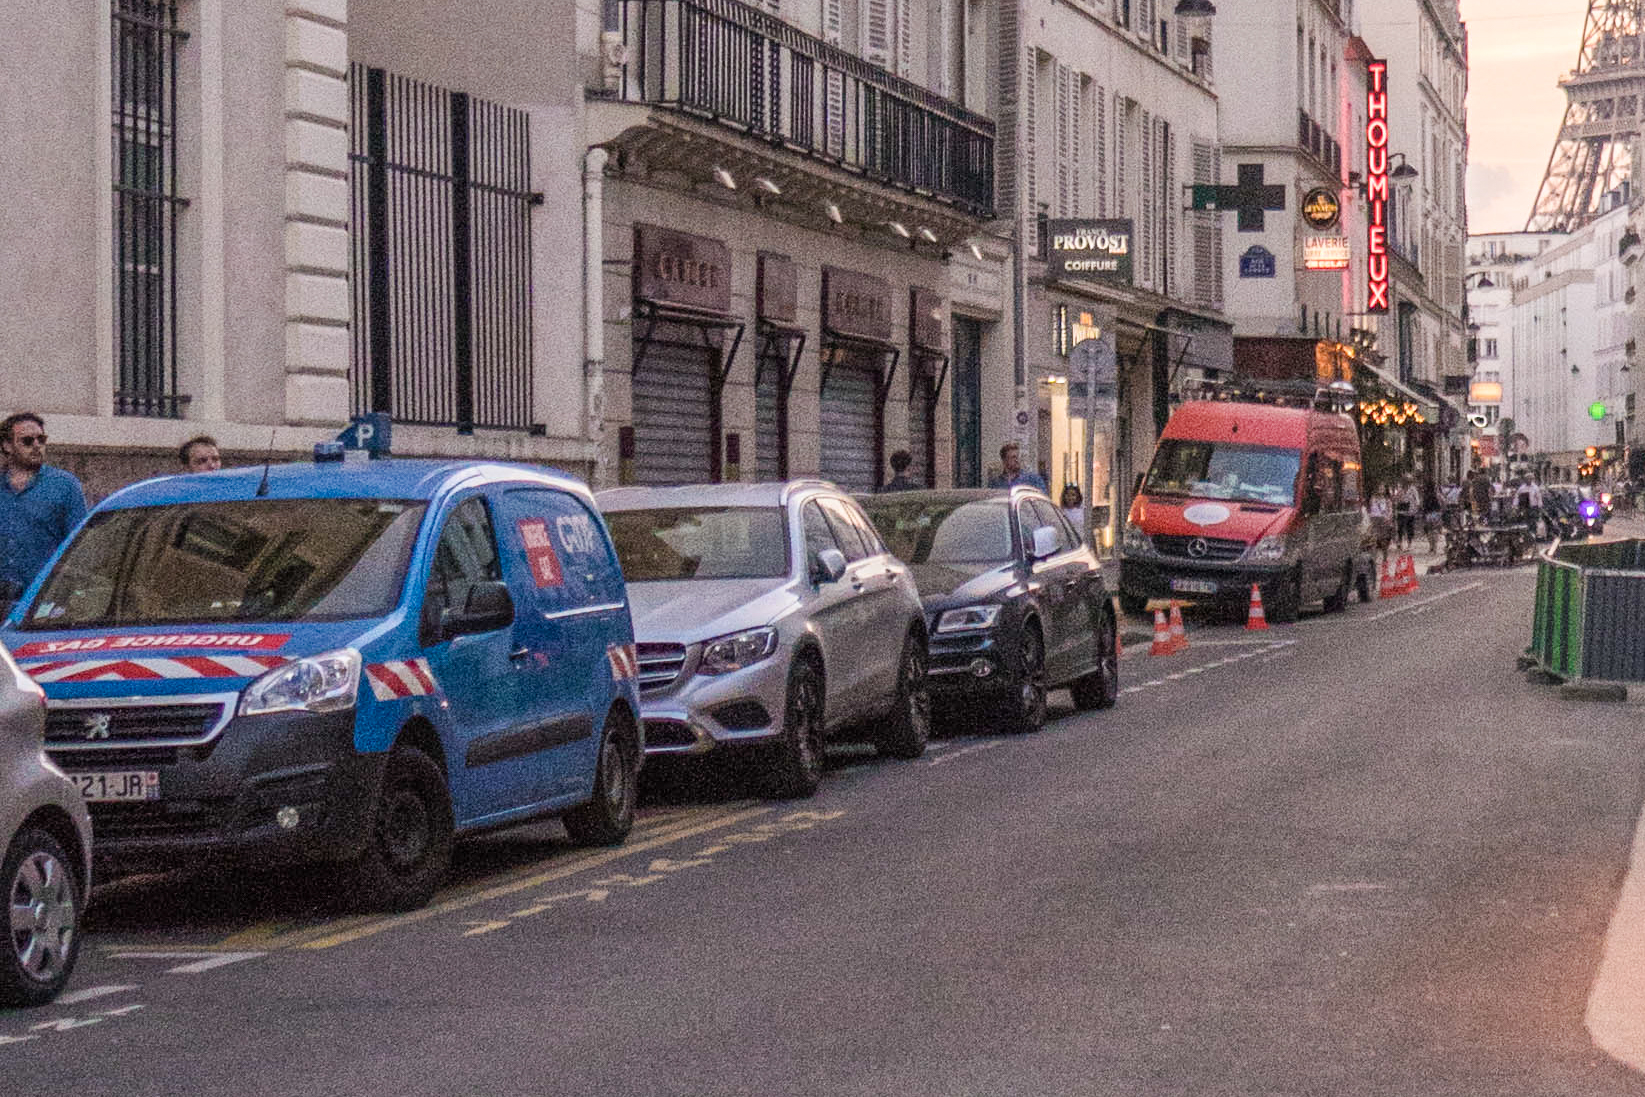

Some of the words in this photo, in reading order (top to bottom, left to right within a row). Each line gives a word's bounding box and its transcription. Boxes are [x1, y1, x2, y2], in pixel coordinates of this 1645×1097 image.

[1366, 62, 1389, 310] THOUMIEUX
[1053, 233, 1128, 250] PROVOST
[1305, 236, 1349, 248] LAVERIE
[1064, 260, 1118, 271] COIFFURE
[357, 424, 374, 448] P
[71, 774, 143, 797] 21-JR
